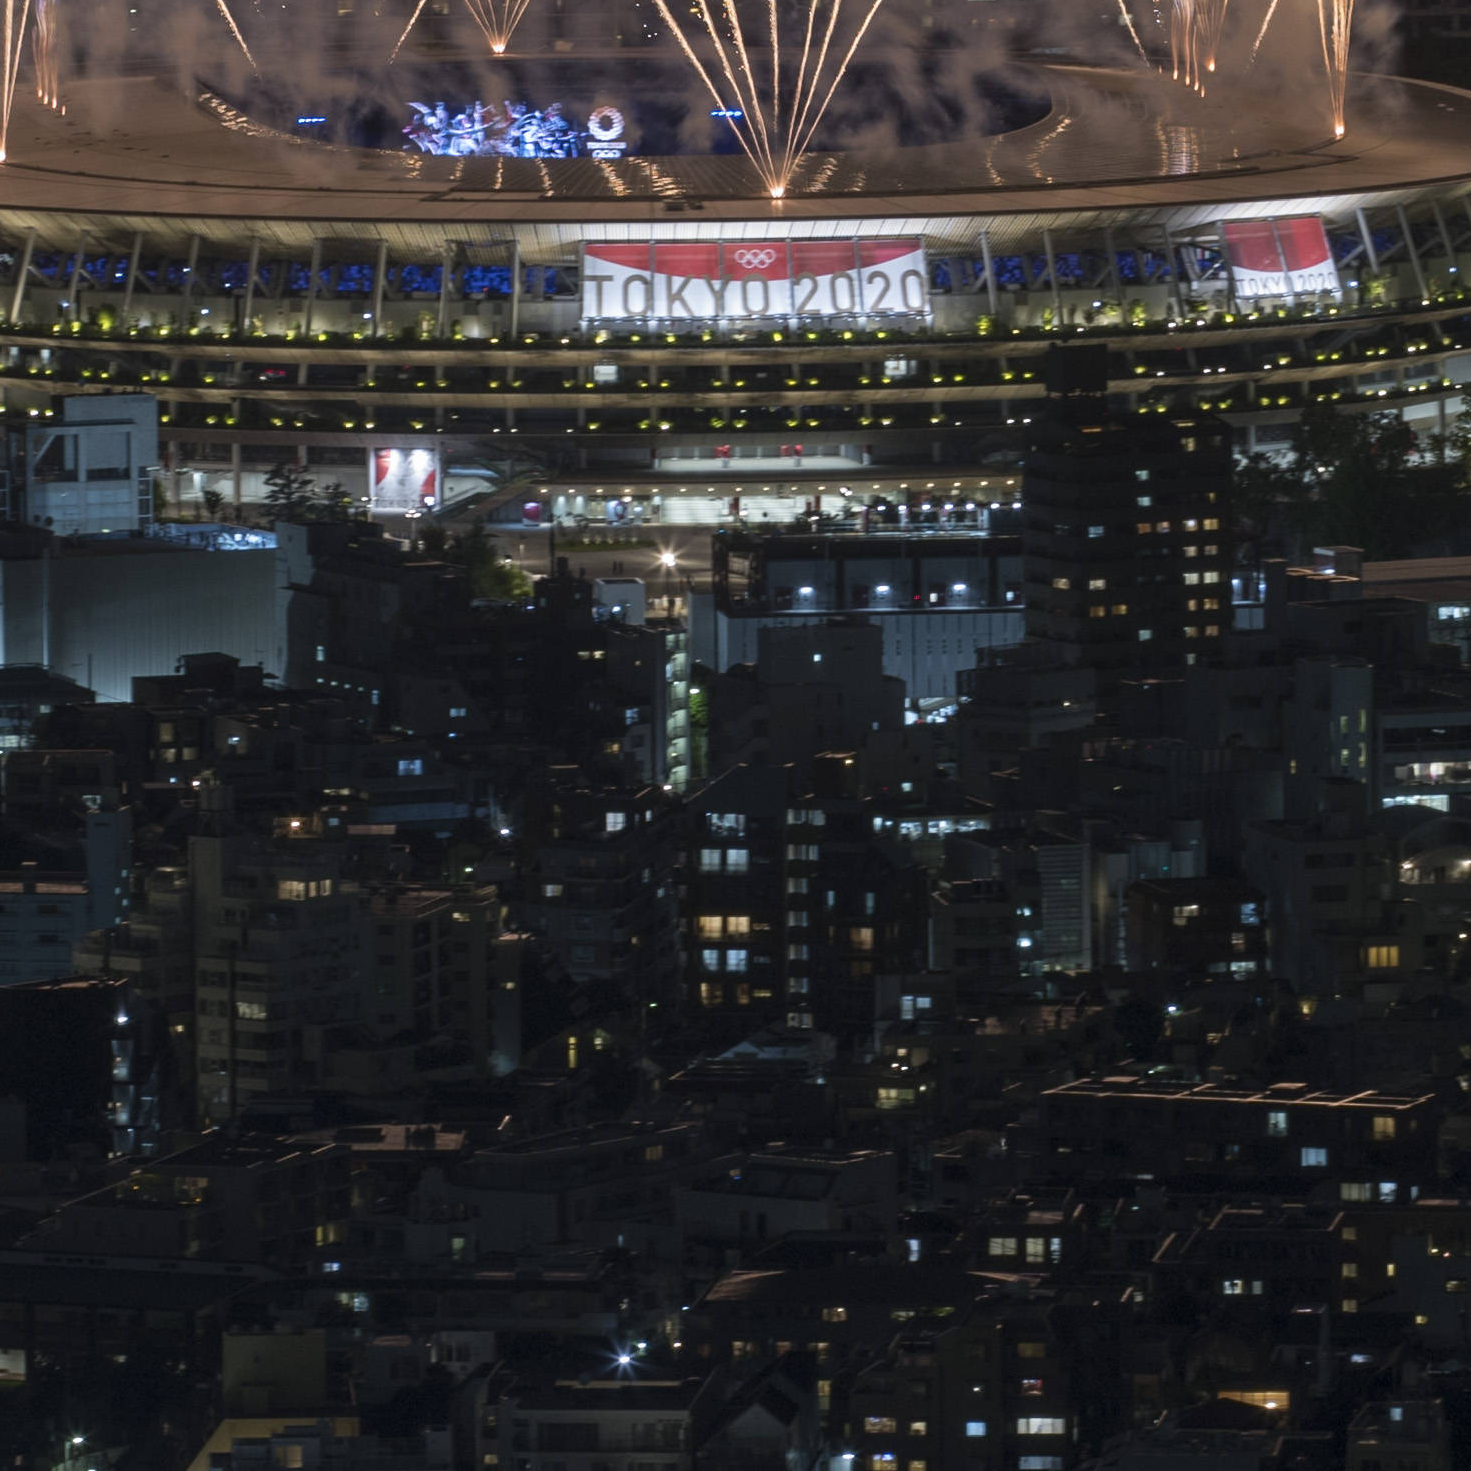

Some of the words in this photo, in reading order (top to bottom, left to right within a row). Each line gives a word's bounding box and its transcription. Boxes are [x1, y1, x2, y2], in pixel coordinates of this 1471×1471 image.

[584, 274, 769, 316] TOKYO
[793, 269, 925, 315] 2020
[1297, 272, 1335, 292] 2020
